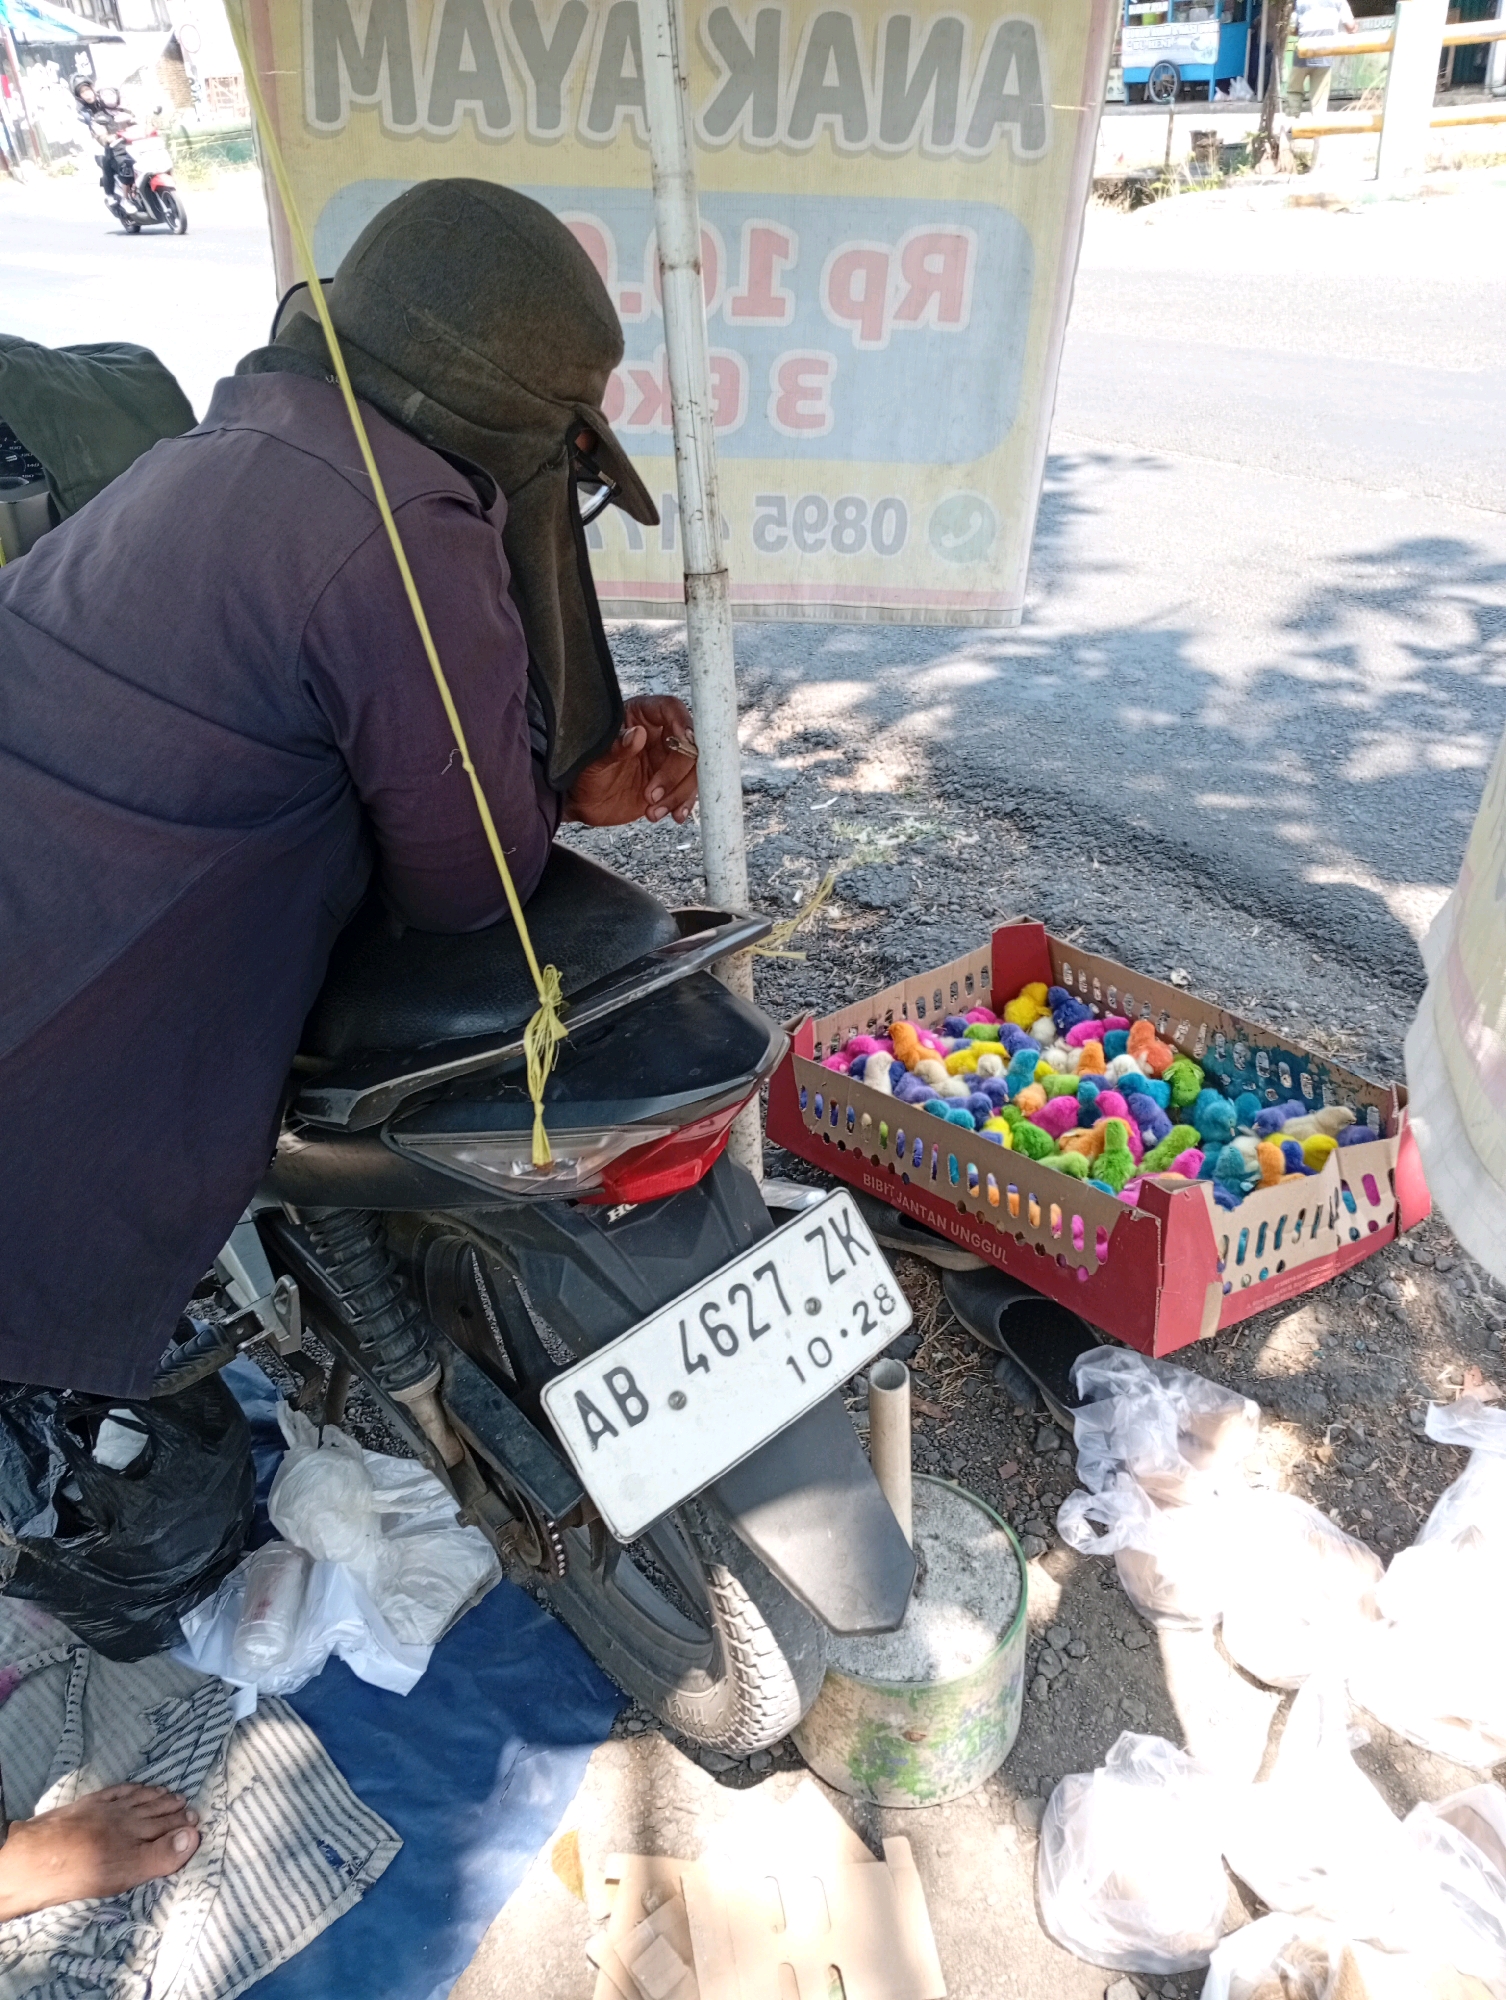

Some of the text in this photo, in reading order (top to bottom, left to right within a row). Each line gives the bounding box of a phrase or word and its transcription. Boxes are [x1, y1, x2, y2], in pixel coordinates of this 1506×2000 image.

[863, 1173, 1009, 1265] BIBIT JANTAN UNGGUL
[573, 1207, 870, 1453] AB 4627 ZK
